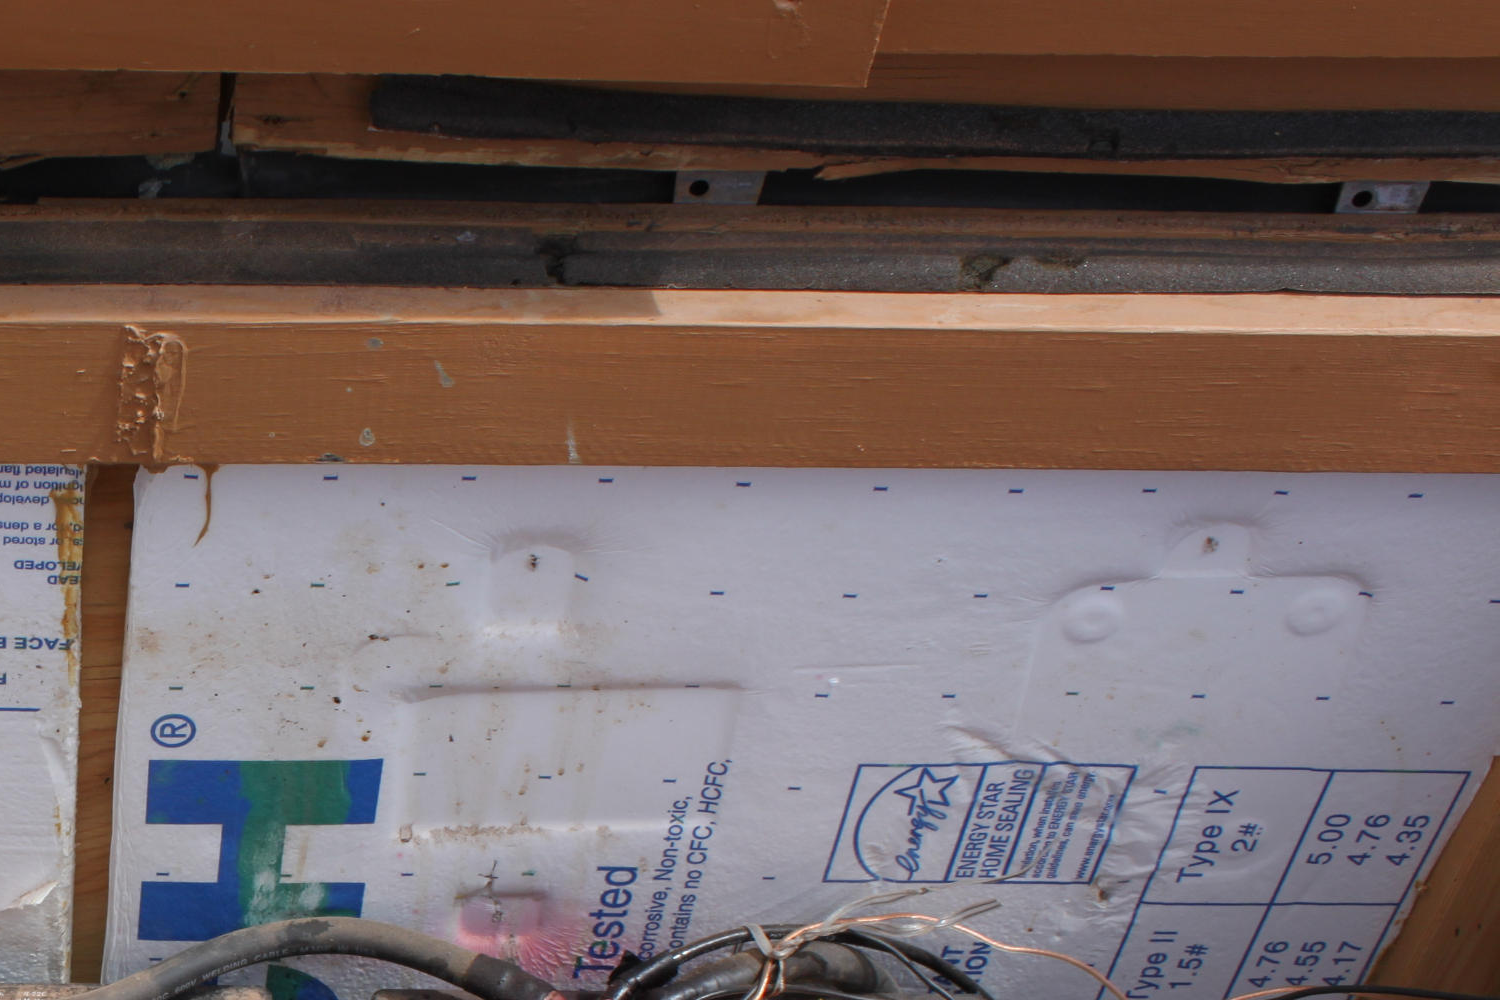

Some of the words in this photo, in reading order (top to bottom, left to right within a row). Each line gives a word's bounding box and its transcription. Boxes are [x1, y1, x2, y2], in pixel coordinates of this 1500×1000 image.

[15, 479, 31, 490] of
[4, 535, 45, 546] stored
[33, 522, 43, 530] a
[14, 636, 75, 651] FACE
[697, 758, 733, 815] HCFC,
[652, 796, 693, 881] Non-toxic,
[687, 821, 717, 866] CFC,
[955, 823, 989, 879] ENERGY
[983, 781, 1007, 823] STAR
[978, 835, 1011, 879] HOME
[997, 767, 1035, 834] SEALING
[1177, 823, 1224, 883] Type
[1205, 788, 1241, 815] IX
[1230, 822, 1263, 853] 2#
[1306, 812, 1352, 867] 5.00
[1347, 813, 1392, 867] 4.76
[1386, 814, 1431, 868] 4.35
[684, 869, 703, 889] no
[572, 865, 639, 979] Tested
[667, 893, 697, 950] ontains
[1169, 942, 1210, 991] 1.5#
[1247, 940, 1290, 990] 4.76
[1286, 940, 1328, 987] 4.55
[1321, 940, 1364, 987] 4.17
